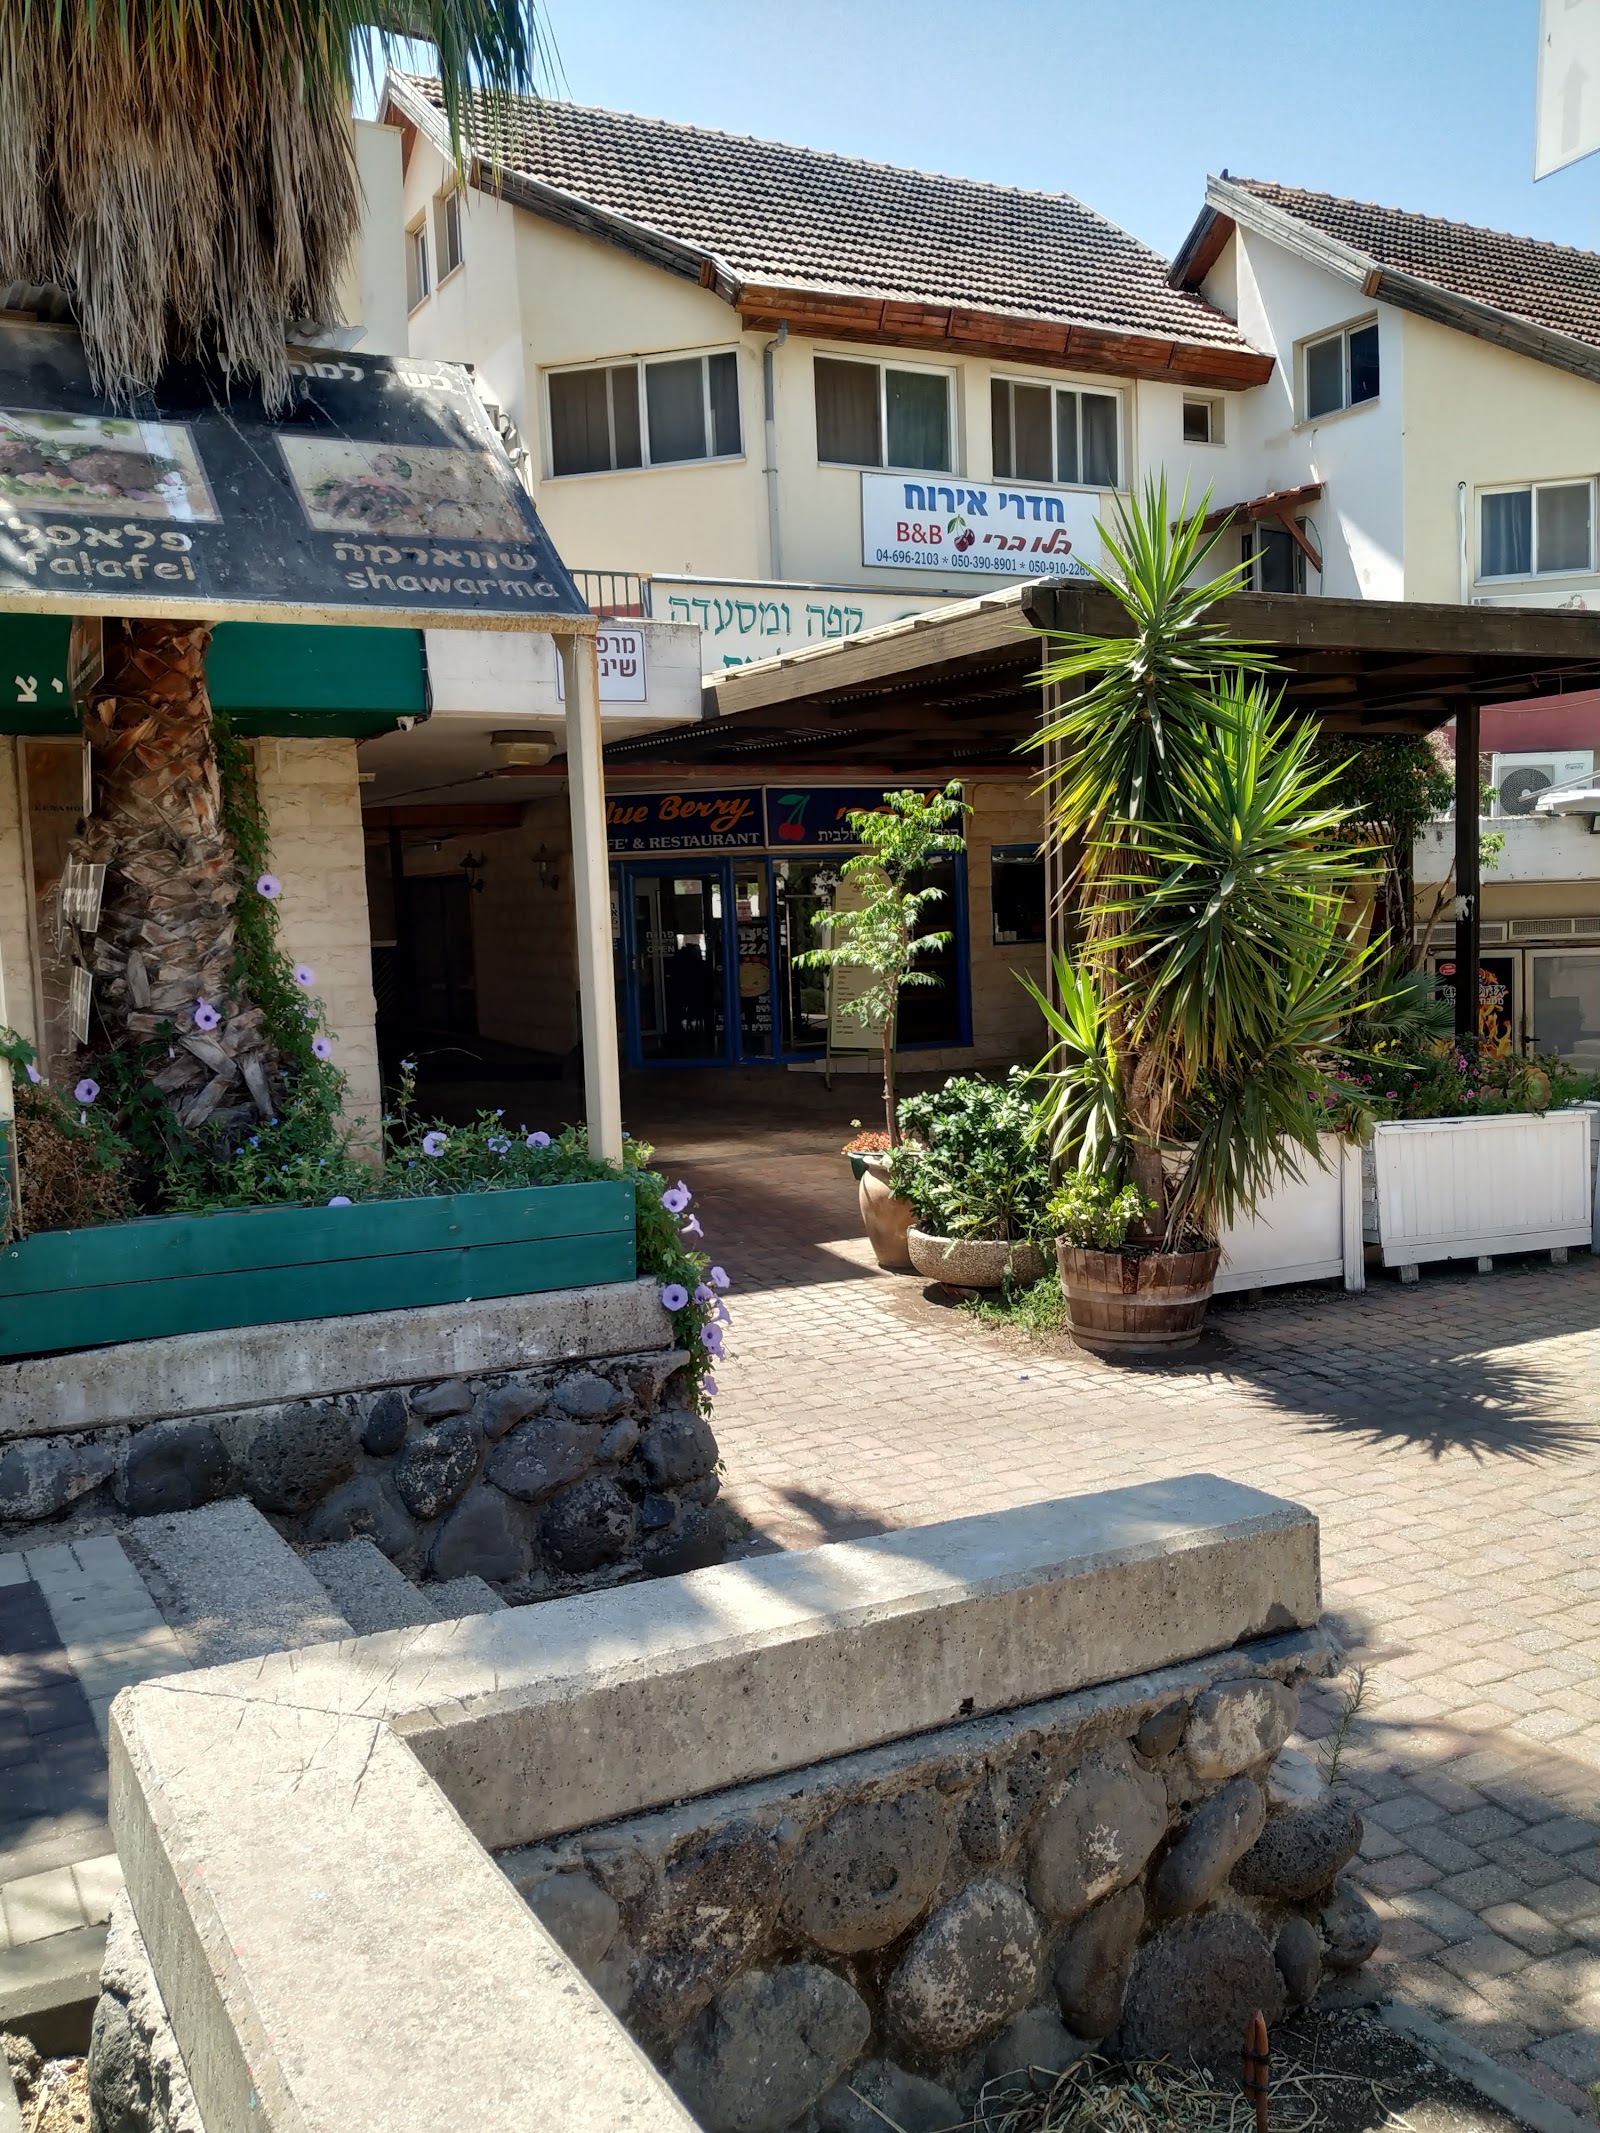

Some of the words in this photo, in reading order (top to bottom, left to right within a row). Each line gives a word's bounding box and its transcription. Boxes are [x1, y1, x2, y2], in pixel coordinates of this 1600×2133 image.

[903, 483, 988, 516] אירוח
[999, 492, 1065, 523] חדרי
[7, 517, 193, 552] פלאפל
[896, 521, 943, 545] B&B
[982, 533, 1026, 551] ברי
[1030, 528, 1073, 555] בלו
[18, 547, 196, 581] falafel
[332, 541, 538, 571] שווארמה
[876, 548, 939, 566] 04-696-2103
[951, 554, 1017, 572] 050-390-8901
[345, 566, 560, 598] shawarma
[805, 603, 864, 638] קפה
[597, 636, 636, 654] מרפ
[600, 658, 637, 678] שינ
[606, 801, 649, 825] lue
[658, 795, 754, 833] Berry
[607, 838, 629, 850] FE'
[632, 838, 645, 849] &
[649, 832, 760, 849] RESTAURANT
